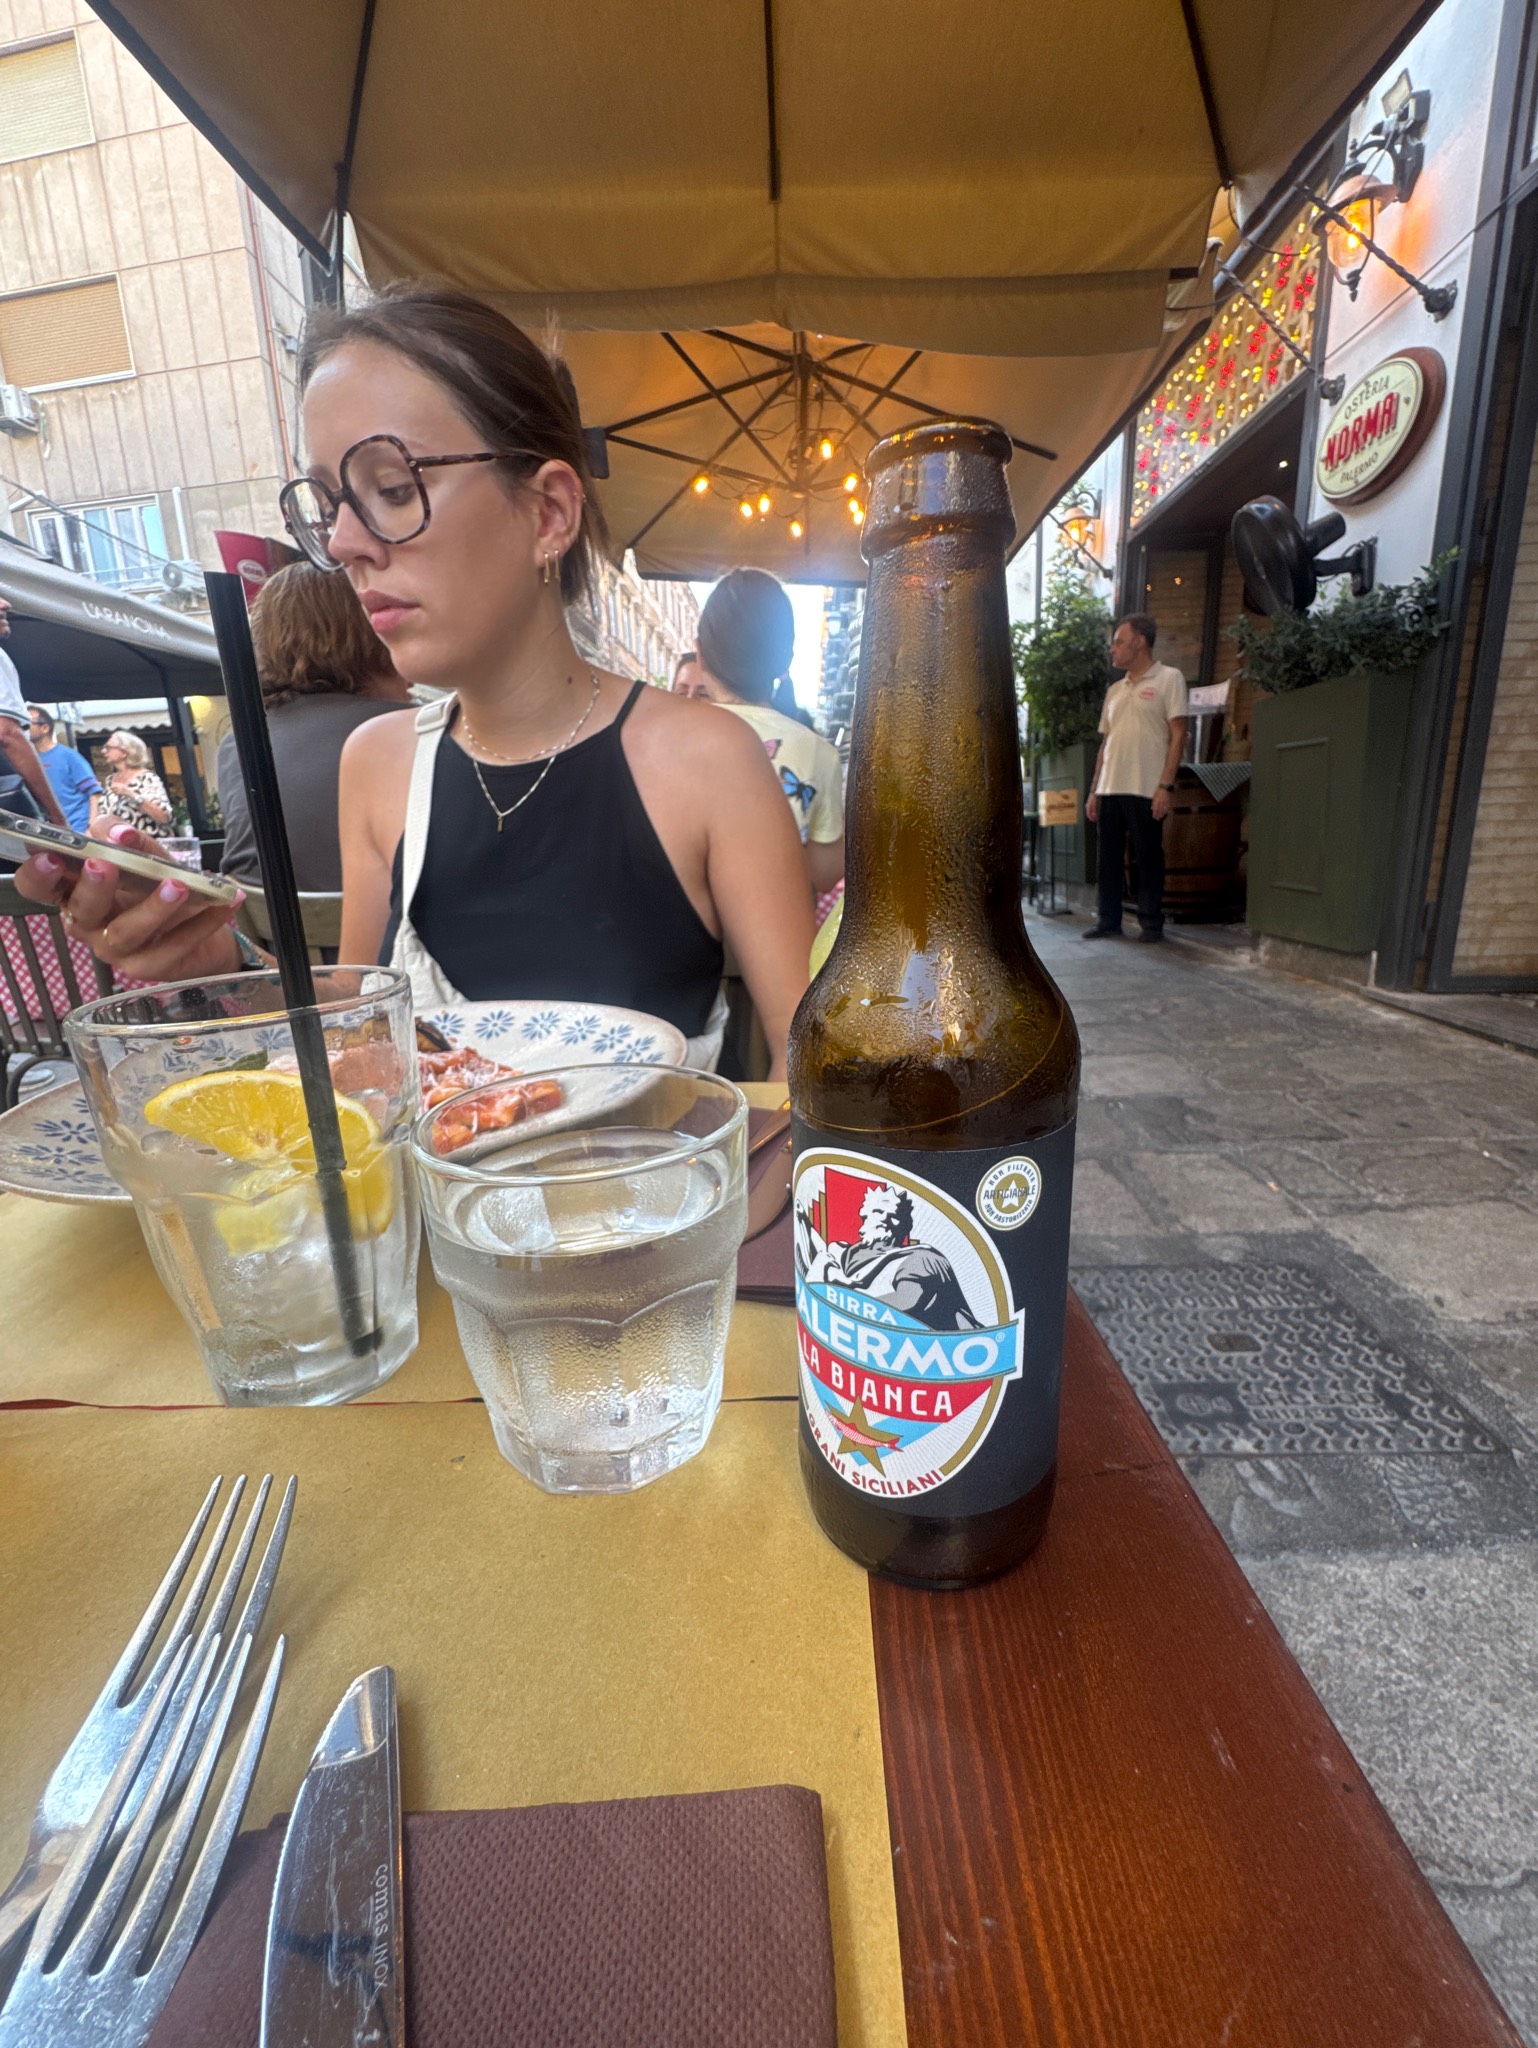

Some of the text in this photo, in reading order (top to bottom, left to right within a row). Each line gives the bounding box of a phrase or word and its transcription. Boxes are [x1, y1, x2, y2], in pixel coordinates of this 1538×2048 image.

[1344, 375, 1390, 420] OSTERIA
[1325, 391, 1399, 472] NORMA
[1340, 452, 1379, 483] PALERMO
[983, 1185, 1036, 1200] ARTIGIANALE
[988, 1163, 1036, 1186] NON FILTRATA
[985, 1199, 1033, 1223] NON PASTORIZZATA
[826, 1285, 898, 1326] BIRRA
[803, 1332, 953, 1417] LA BIANCA
[808, 1412, 943, 1496] GRANI SICILIANI
[374, 1942, 389, 1987] INOX
